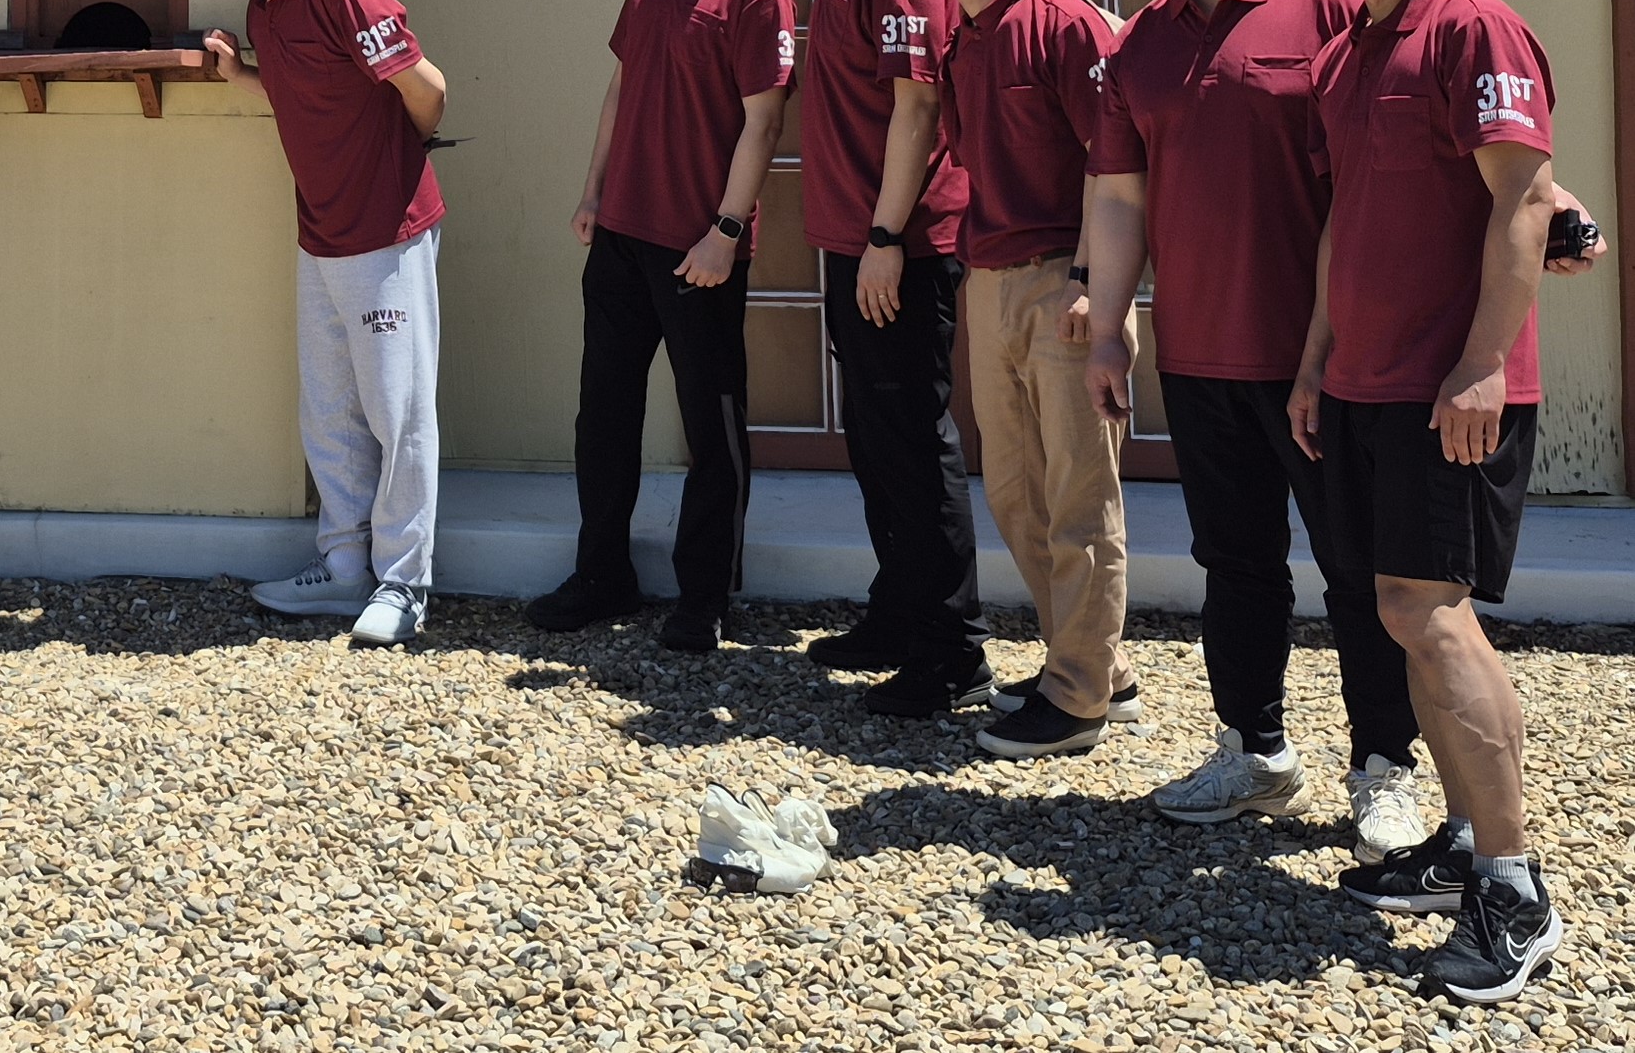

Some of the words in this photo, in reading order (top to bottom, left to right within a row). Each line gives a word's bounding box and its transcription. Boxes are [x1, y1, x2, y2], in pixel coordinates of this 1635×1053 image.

[356, 16, 398, 57] 31ST
[881, 14, 928, 43] 31ST
[1476, 72, 1534, 110] 31ST
